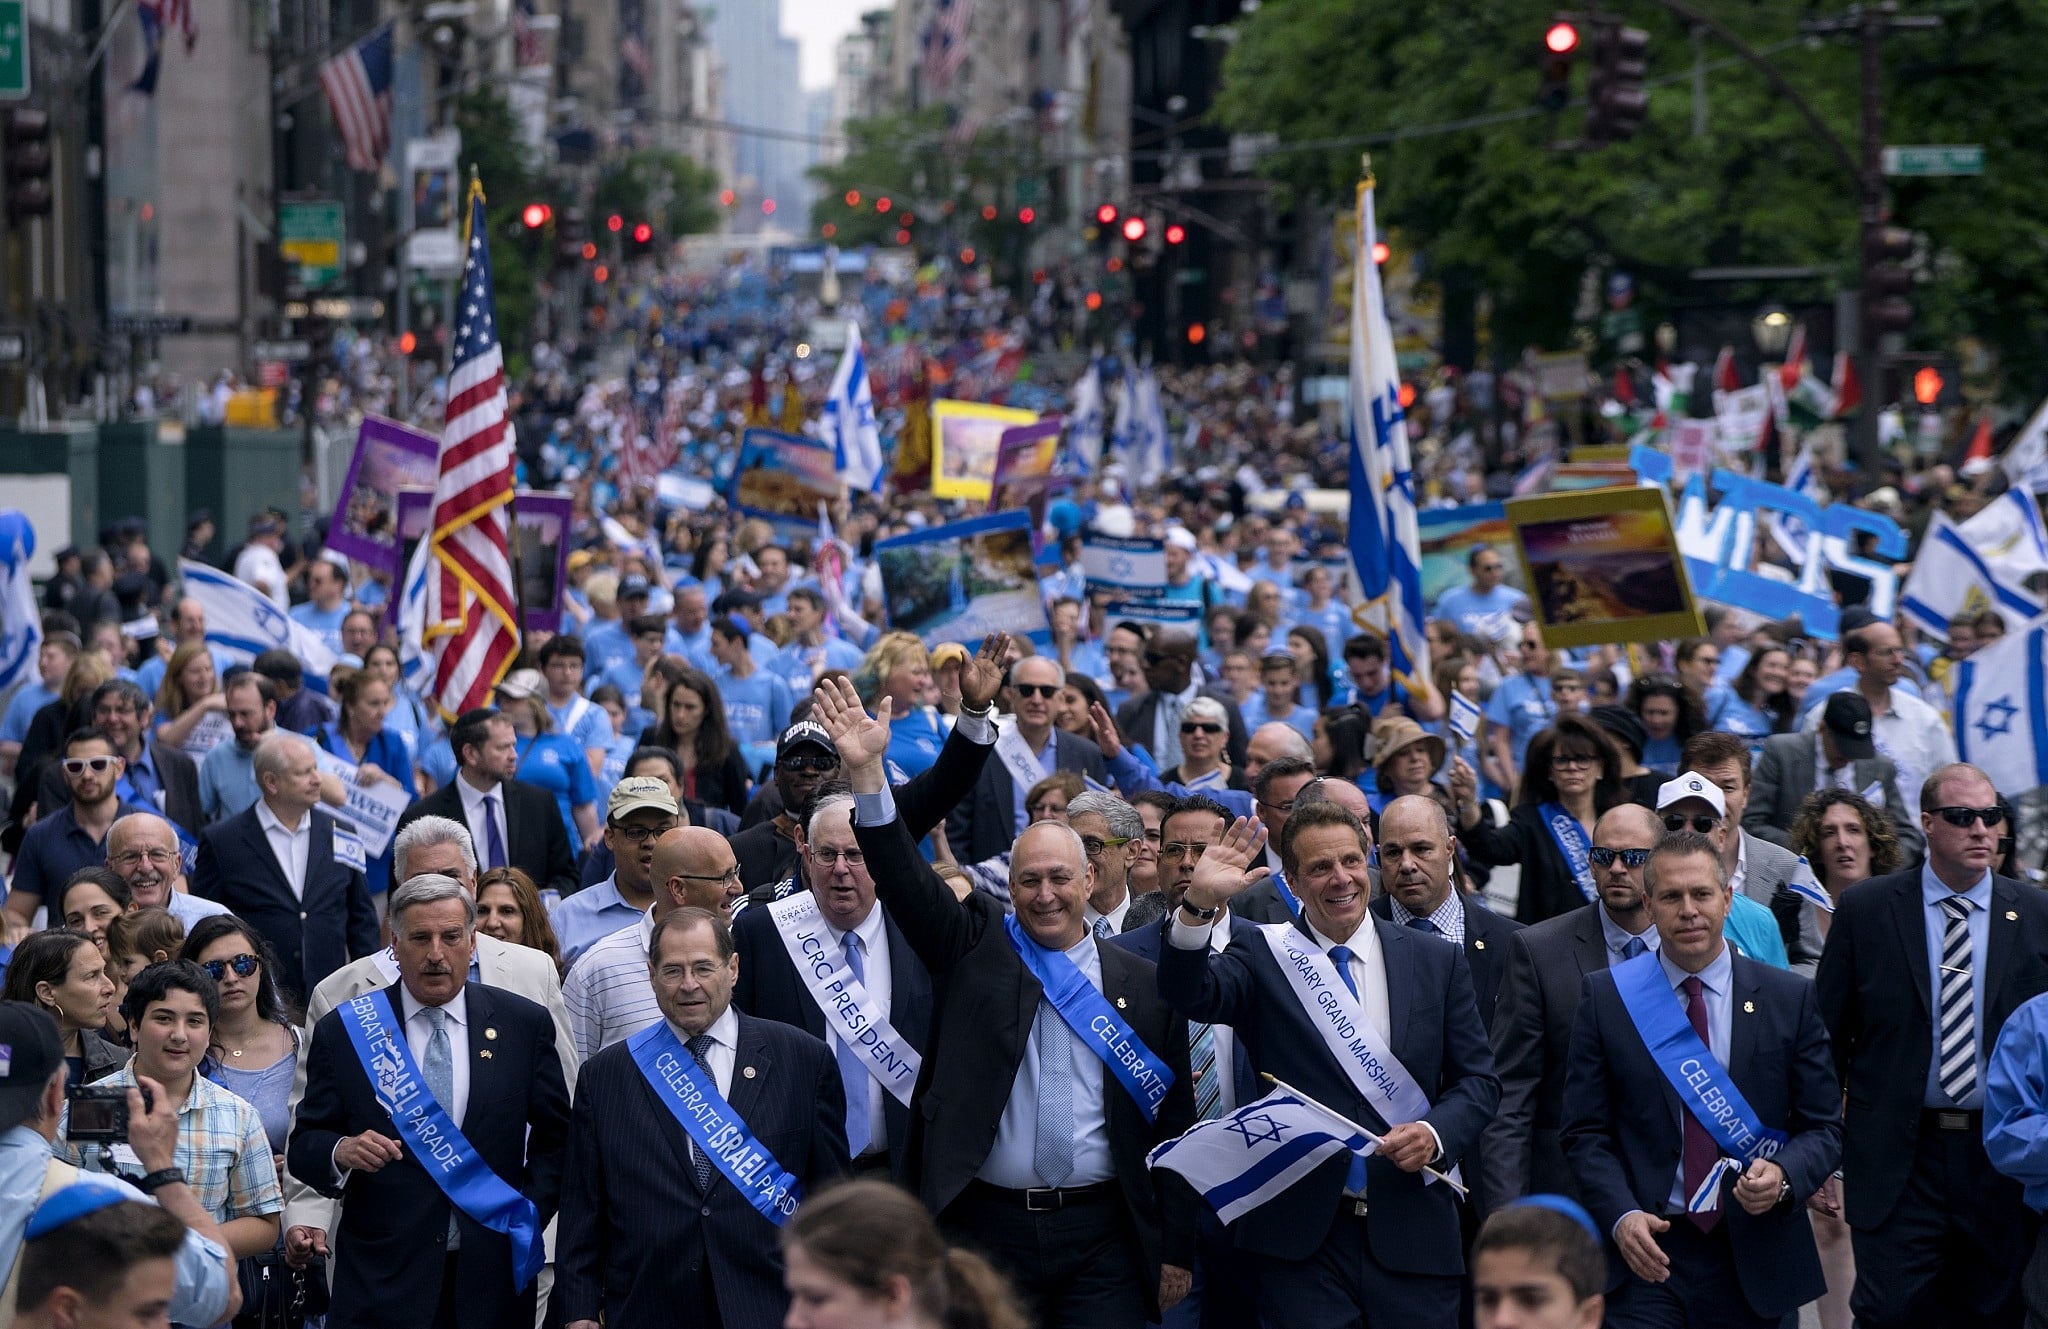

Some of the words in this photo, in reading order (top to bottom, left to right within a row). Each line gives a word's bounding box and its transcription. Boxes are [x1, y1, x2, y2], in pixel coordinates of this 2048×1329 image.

[784, 720, 831, 743] JERUSALEM
[778, 905, 812, 922] ISRAEL
[796, 932, 834, 980] JCRC
[824, 980, 913, 1080] PRESIDENT
[1317, 990, 1356, 1040] GRAND
[1348, 1038, 1401, 1102] MARSHAL
[1090, 1015, 1167, 1101] CELEBRATE
[405, 1104, 463, 1173] PARADE
[655, 1052, 723, 1134] CELEBRATE
[707, 1121, 766, 1186] ISRAEL
[1680, 1059, 1756, 1150] CELEBRATE
[1743, 1137, 1784, 1161] ISR
